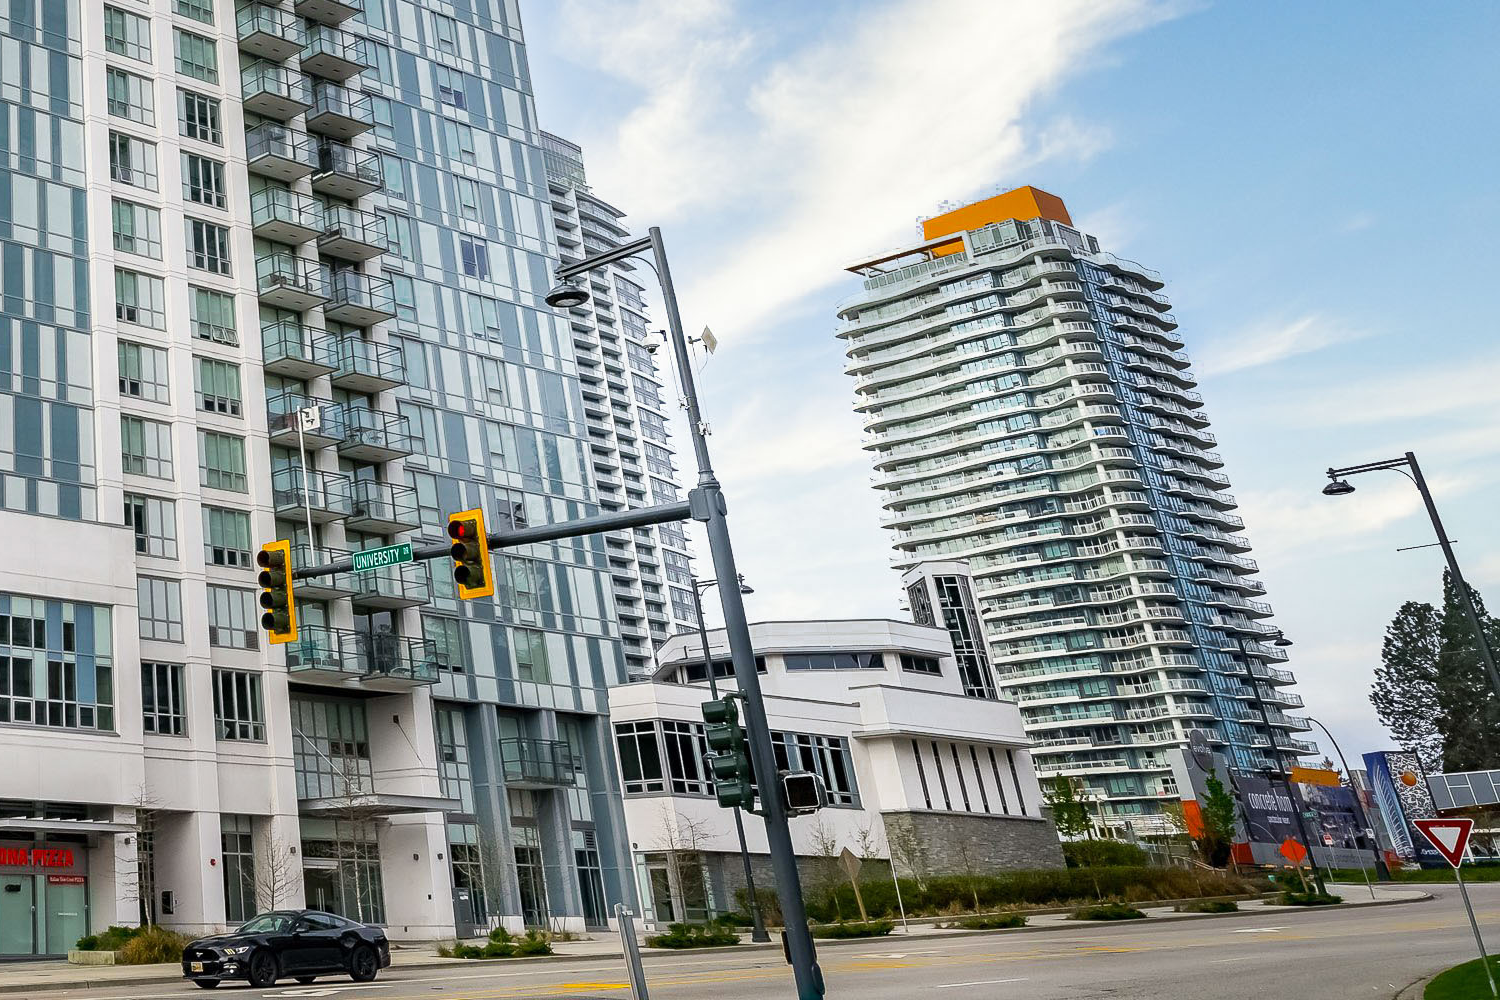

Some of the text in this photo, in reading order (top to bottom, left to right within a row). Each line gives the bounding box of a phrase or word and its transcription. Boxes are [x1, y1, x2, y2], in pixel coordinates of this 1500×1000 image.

[355, 546, 409, 568] UNIVERSITY DR
[1248, 790, 1278, 811] concrete
[31, 848, 74, 867] PIZZA
